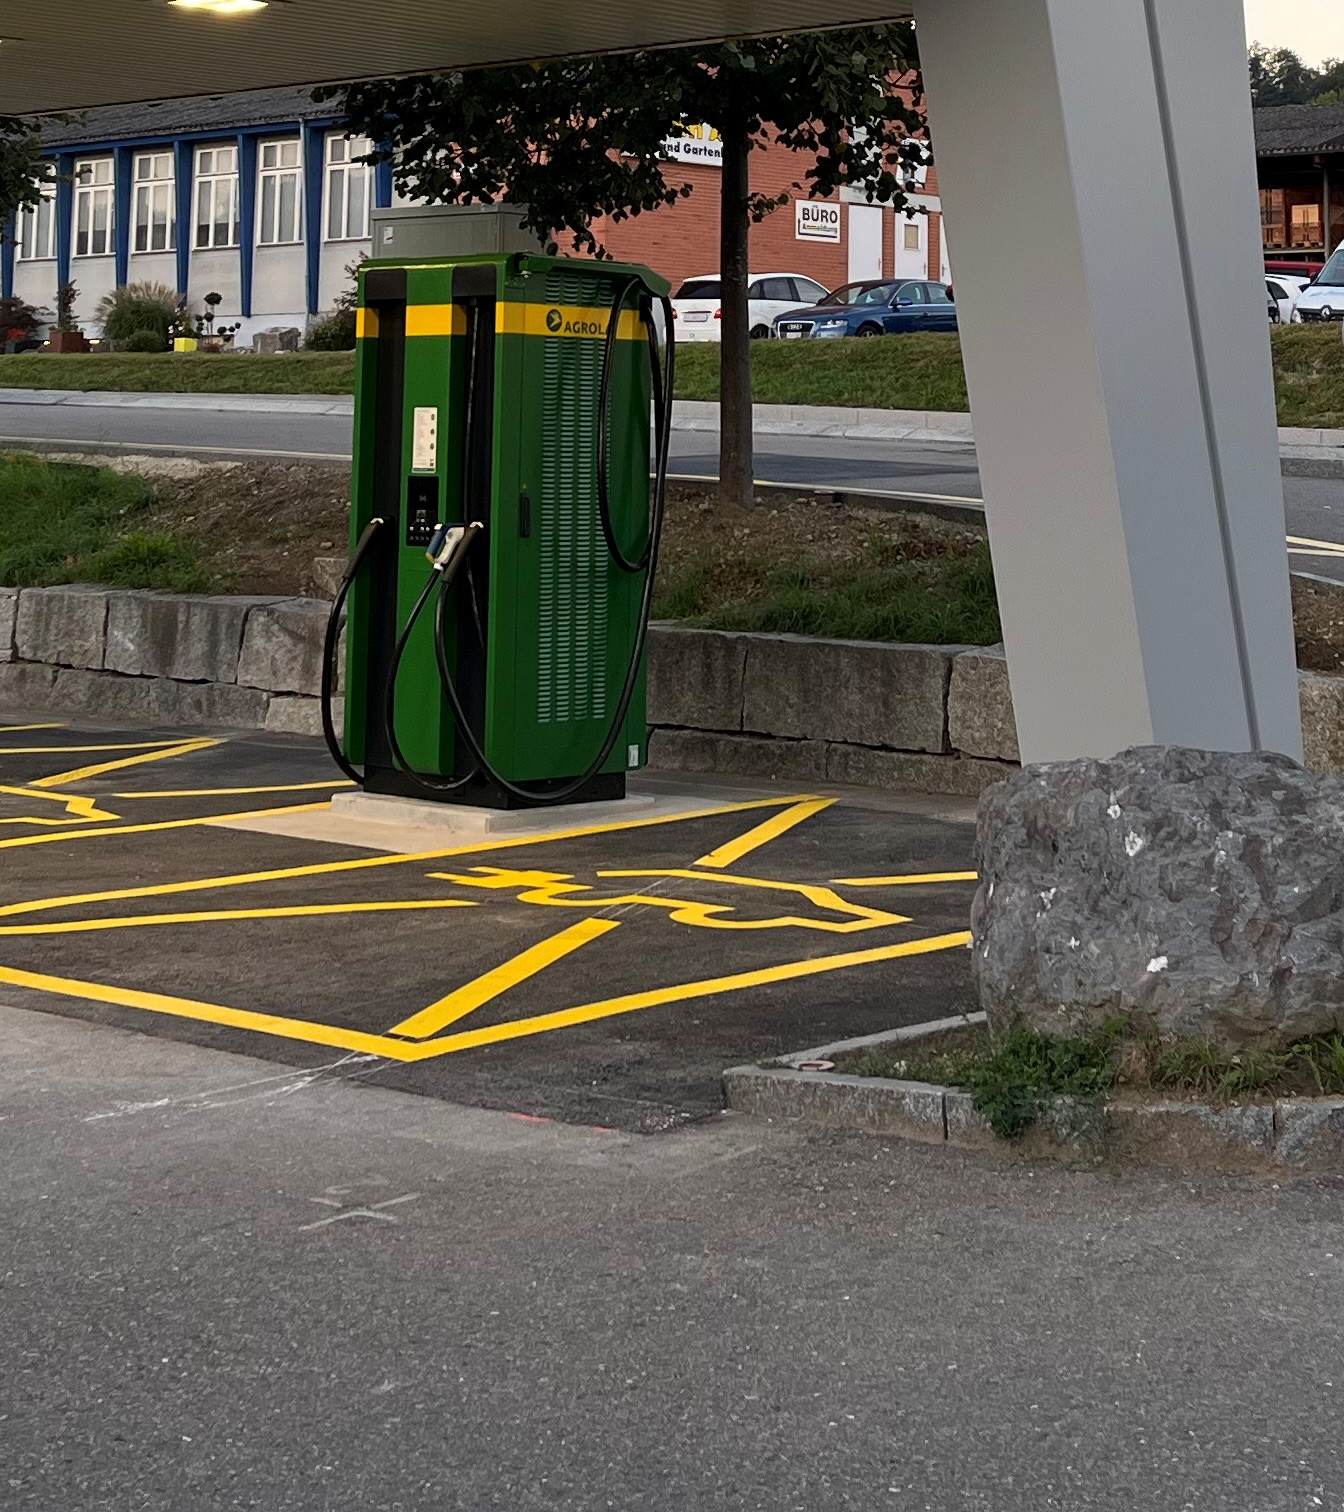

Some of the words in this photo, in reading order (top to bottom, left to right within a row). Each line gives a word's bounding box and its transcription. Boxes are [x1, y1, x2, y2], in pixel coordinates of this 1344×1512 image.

[683, 143, 722, 158] Garten
[802, 205, 838, 224] BÜRO
[564, 320, 607, 335] AGROL
